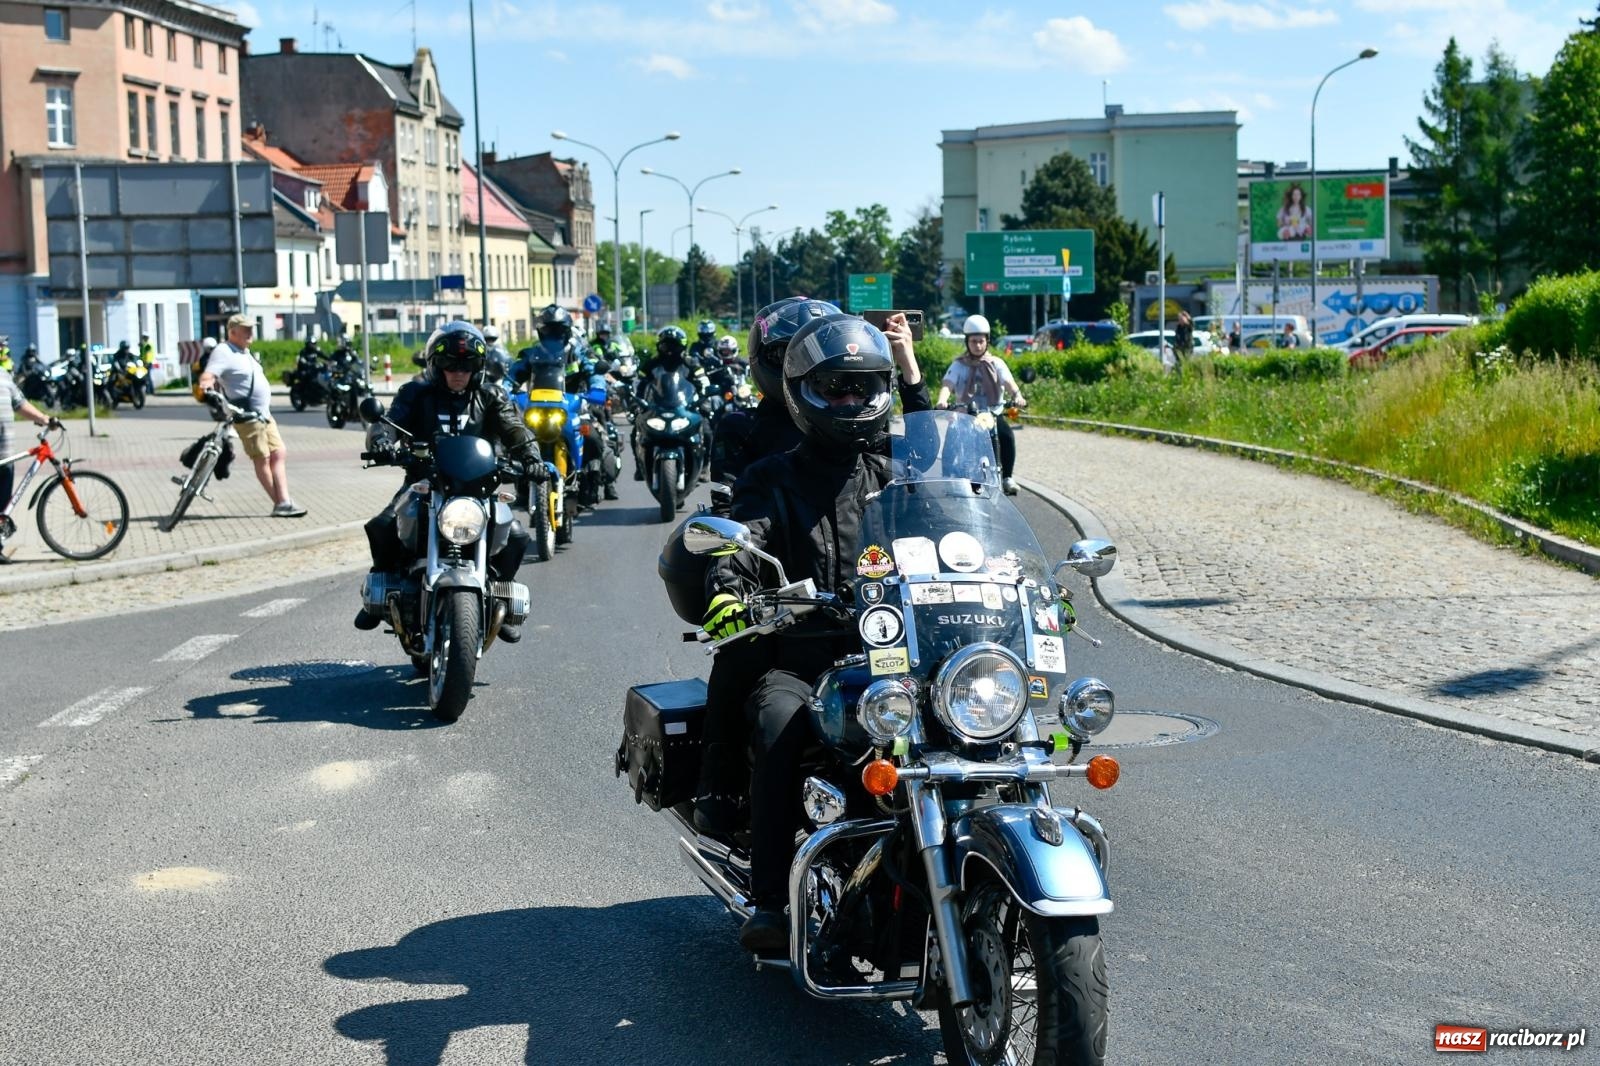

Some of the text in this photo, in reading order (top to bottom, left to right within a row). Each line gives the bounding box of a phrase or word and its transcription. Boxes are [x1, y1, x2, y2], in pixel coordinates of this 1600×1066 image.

[1003, 234, 1032, 242] Rybnik
[1003, 282, 1030, 291] Opole
[937, 614, 1004, 626] SUZUKI
[881, 660, 900, 669] ZLOT
